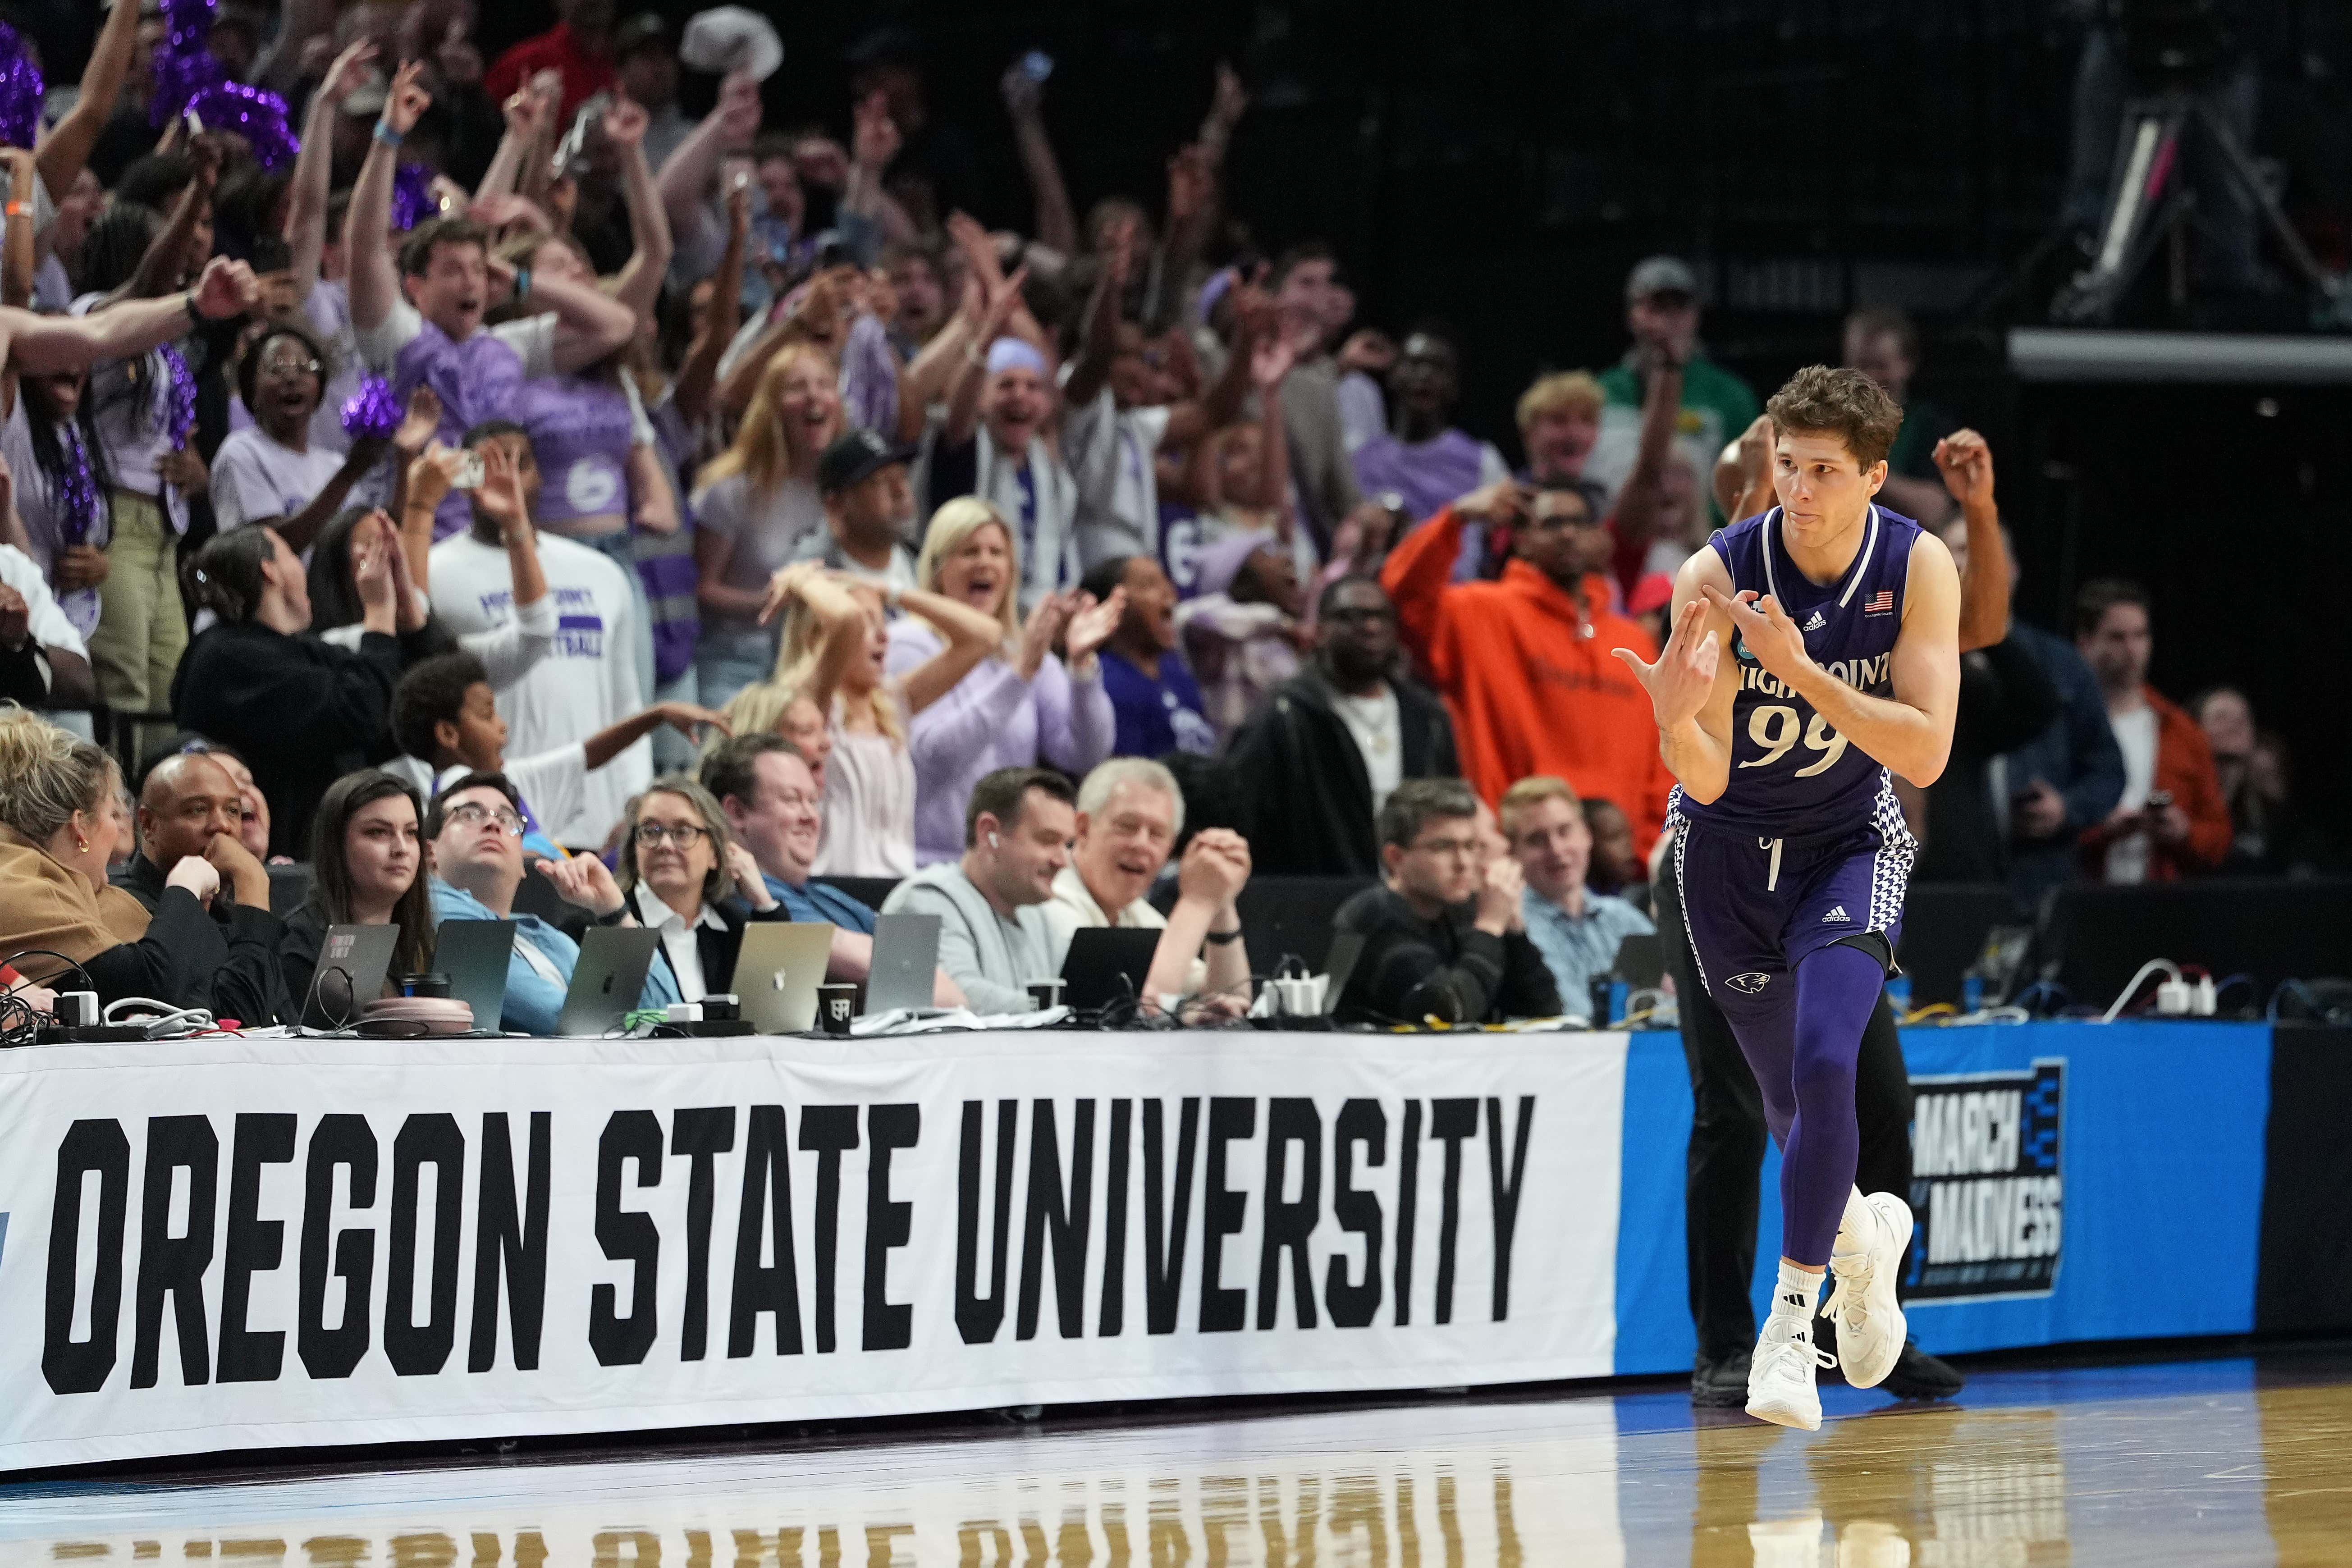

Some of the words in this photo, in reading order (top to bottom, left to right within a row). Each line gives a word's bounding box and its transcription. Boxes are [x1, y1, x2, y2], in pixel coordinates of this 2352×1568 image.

[1803, 620, 1826, 631] adidas
[1816, 651, 1890, 691] OINT
[1738, 705, 1849, 777] 99
[1913, 1090, 2021, 1177] MARCH
[41, 1111, 551, 1395] OREGON
[589, 1103, 920, 1367] STATE
[955, 1095, 1535, 1345] UNIVERSITY
[1928, 1175, 2062, 1264] MADNESS
